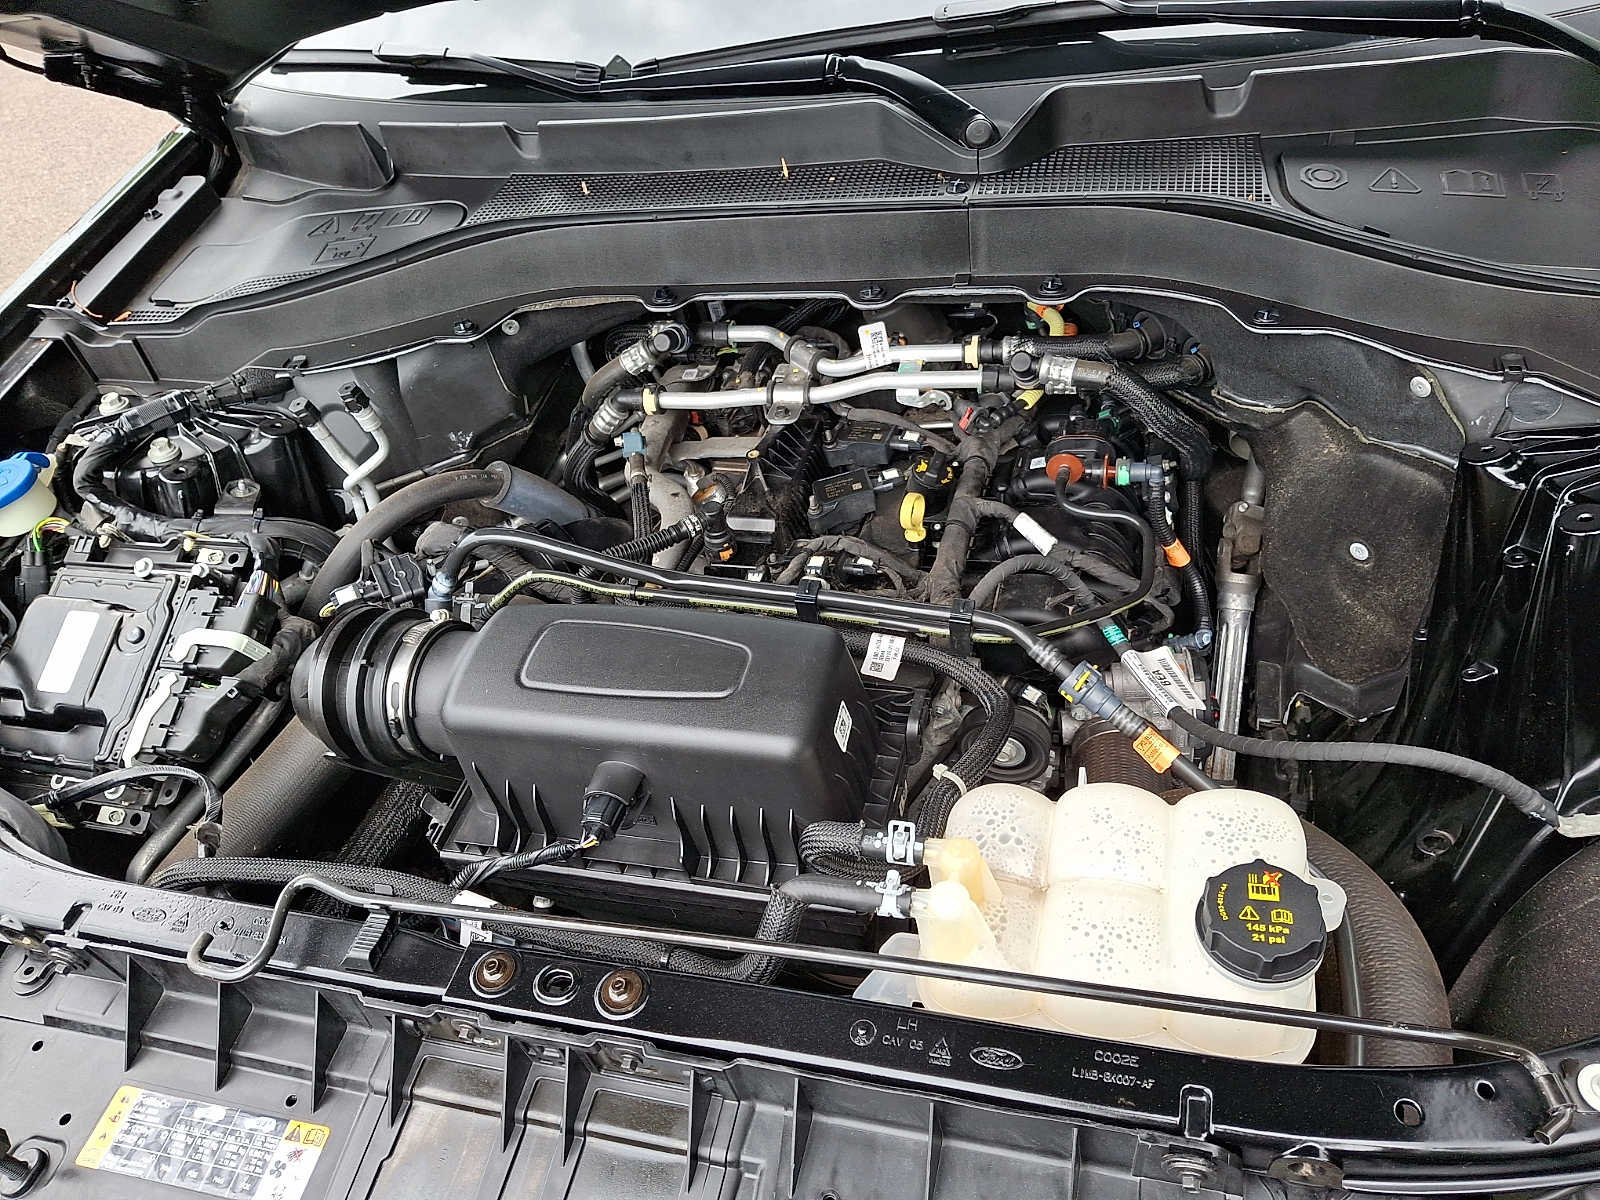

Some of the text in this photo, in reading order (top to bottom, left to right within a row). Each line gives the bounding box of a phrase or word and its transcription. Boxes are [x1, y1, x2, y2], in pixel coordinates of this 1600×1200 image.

[1246, 922, 1290, 935] 145 kPa
[1252, 933, 1286, 945] 21 psi
[896, 1017, 918, 1031] LH
